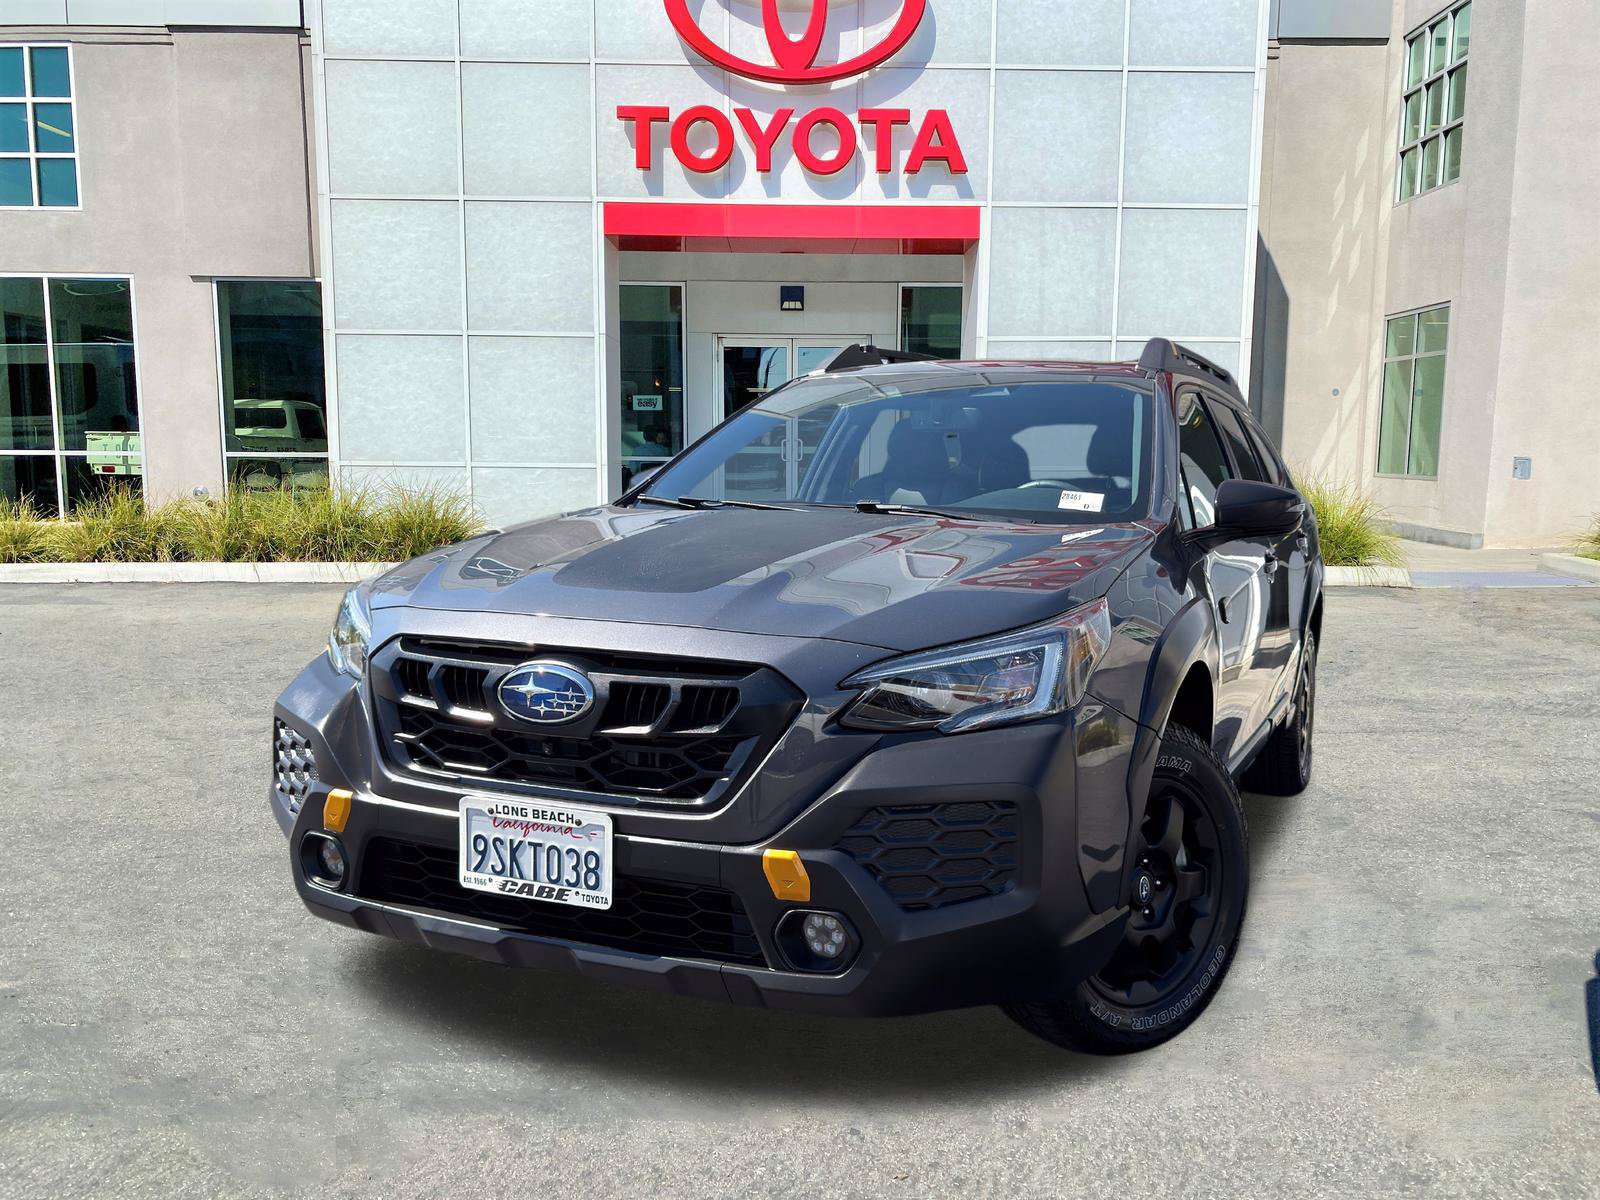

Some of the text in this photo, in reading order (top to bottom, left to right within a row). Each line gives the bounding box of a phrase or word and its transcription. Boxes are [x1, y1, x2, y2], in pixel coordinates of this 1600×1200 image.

[617, 105, 968, 175] TOYOTA
[495, 804, 575, 824] LONG BEACH
[473, 834, 600, 891] 9SKT038
[498, 879, 573, 902] CABE
[581, 893, 609, 905] TOYOTA
[1089, 944, 1226, 1030] GEOLANDAR A/T
